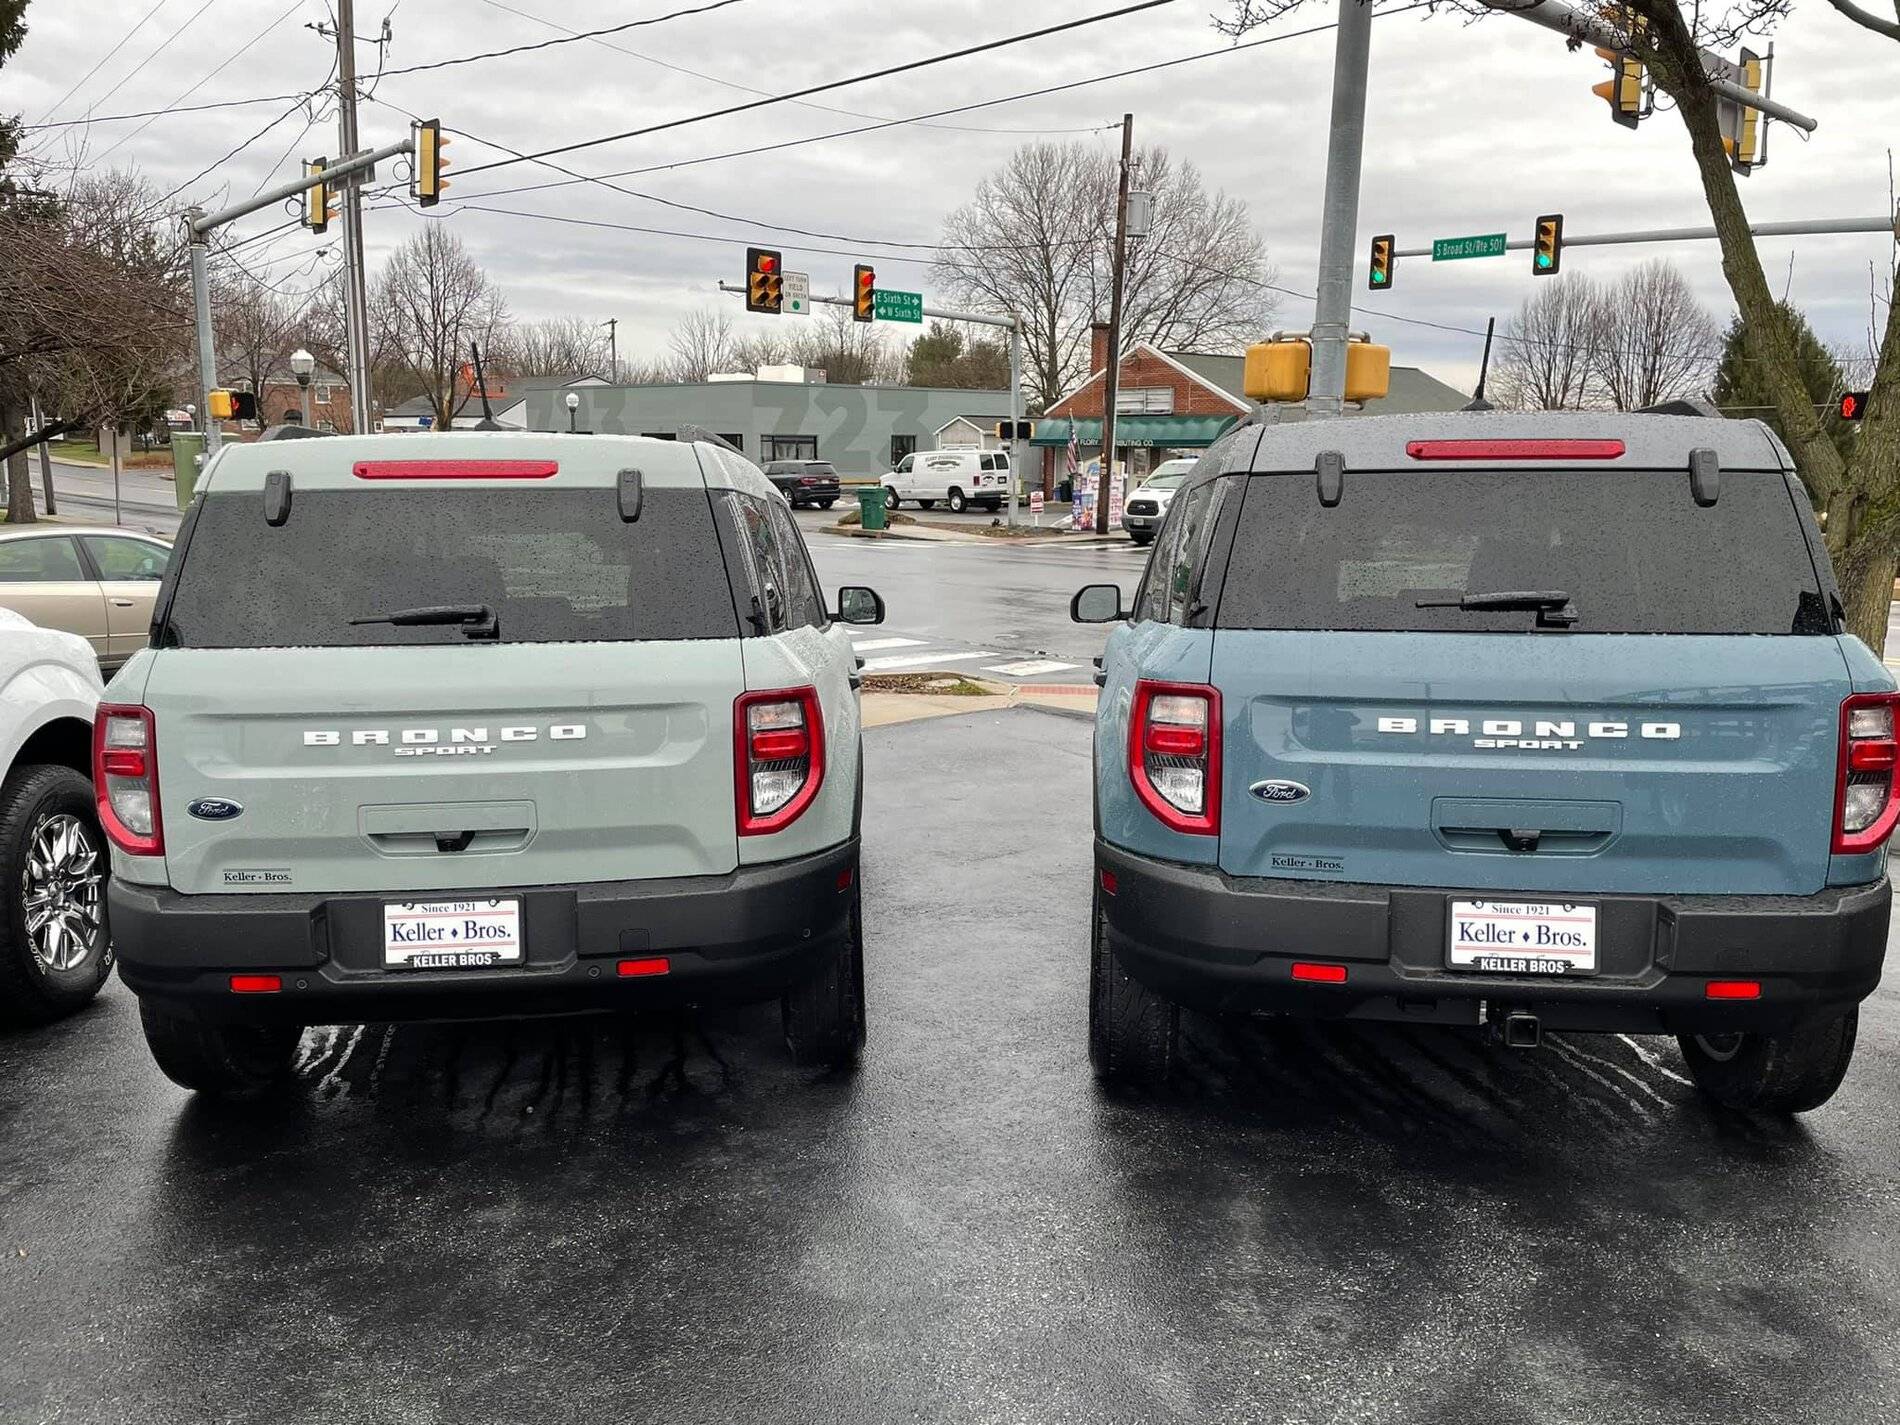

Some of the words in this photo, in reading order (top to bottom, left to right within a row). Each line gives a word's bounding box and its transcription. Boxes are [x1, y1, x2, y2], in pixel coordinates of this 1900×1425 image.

[1436, 243, 1441, 256] S
[1443, 242, 1463, 255] Broad
[1490, 238, 1503, 251] 501
[883, 293, 901, 304] Sixth
[903, 295, 911, 305] St
[895, 307, 912, 318] Sixth
[913, 309, 920, 319] St
[1378, 717, 1681, 739] BRONCO
[303, 724, 587, 746] BRONCO
[394, 745, 498, 756] SPORT
[1473, 739, 1585, 750] SPORT
[1272, 857, 1307, 867] Keller
[1315, 859, 1344, 869] Bros.
[224, 872, 257, 881] Keller
[264, 872, 292, 881] Bros.
[421, 904, 450, 913] Since
[453, 902, 476, 912] 1921
[1491, 904, 1521, 915] Since
[1526, 905, 1550, 915] 1921
[390, 922, 445, 942] Keller
[463, 920, 511, 940] Bros.
[1458, 922, 1515, 943] Keller
[1535, 924, 1587, 946] Bros.
[413, 954, 457, 968] KELLER
[1481, 957, 1527, 972] KELLER
